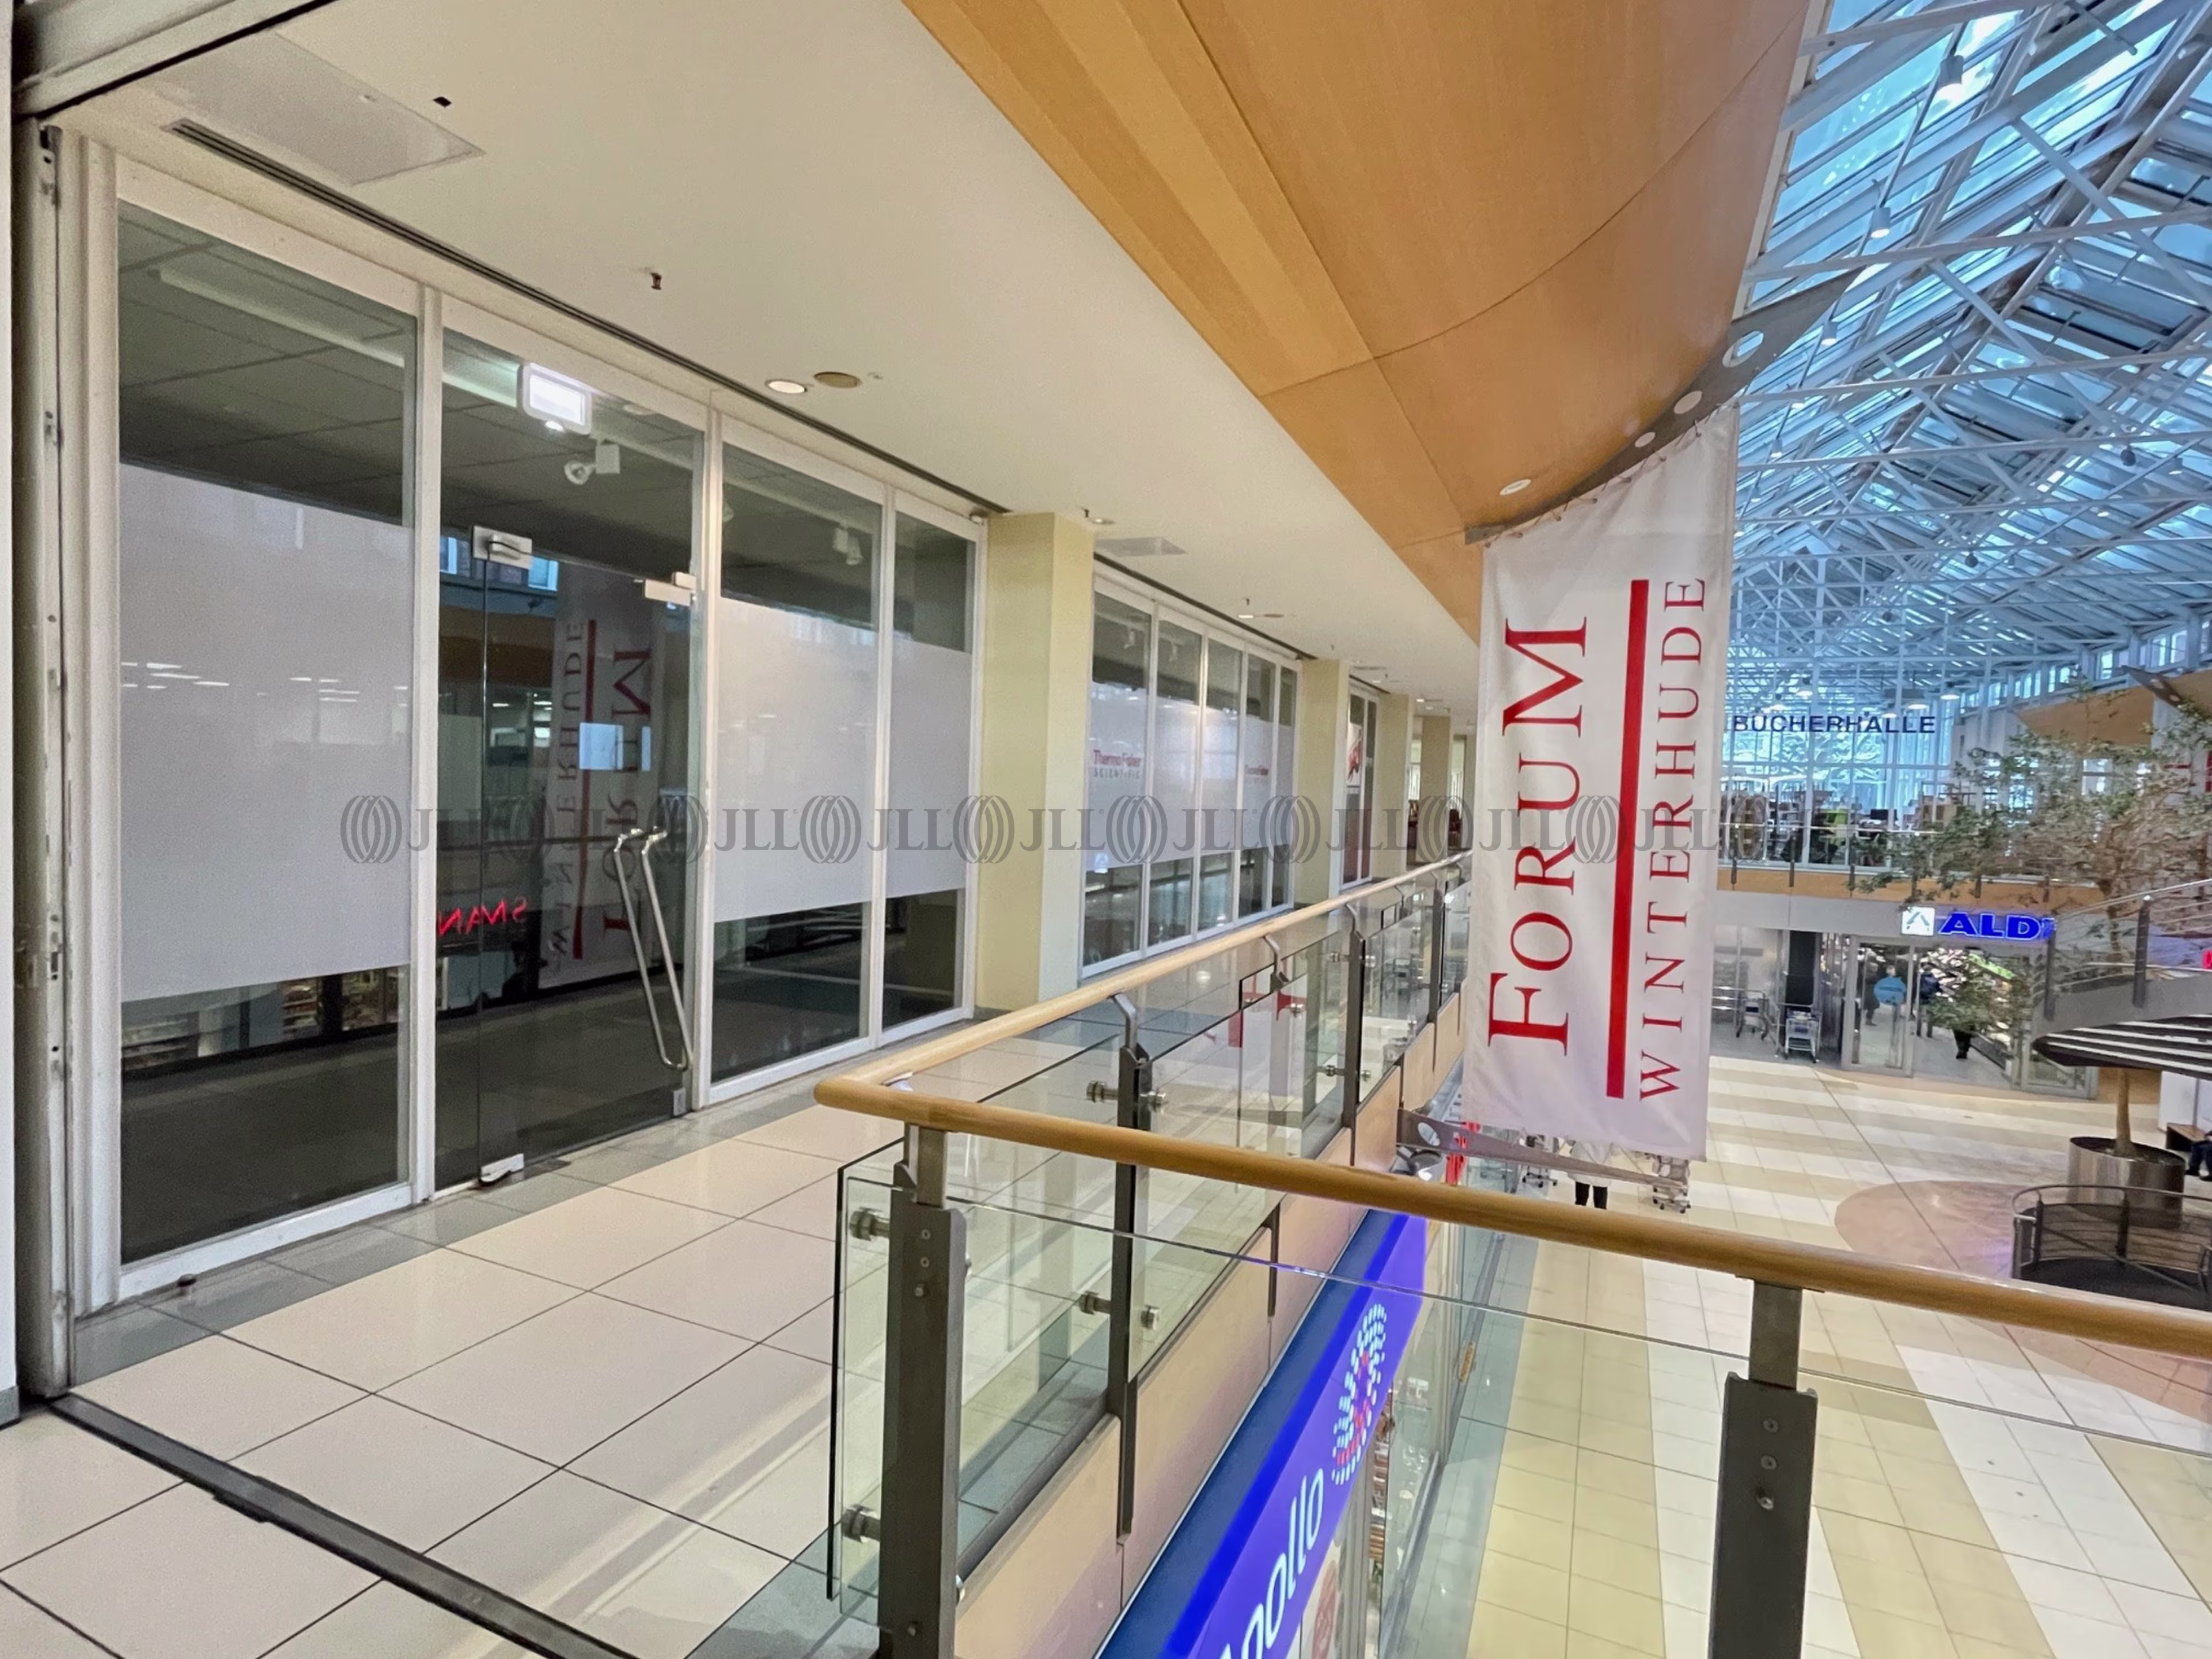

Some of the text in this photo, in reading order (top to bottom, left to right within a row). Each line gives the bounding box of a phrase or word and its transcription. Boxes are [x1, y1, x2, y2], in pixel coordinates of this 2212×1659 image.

[1487, 616, 1587, 1056] FORUM
[1639, 578, 1706, 1100] WINTERHUDE
[1219, 1467, 1324, 1659] ollo
